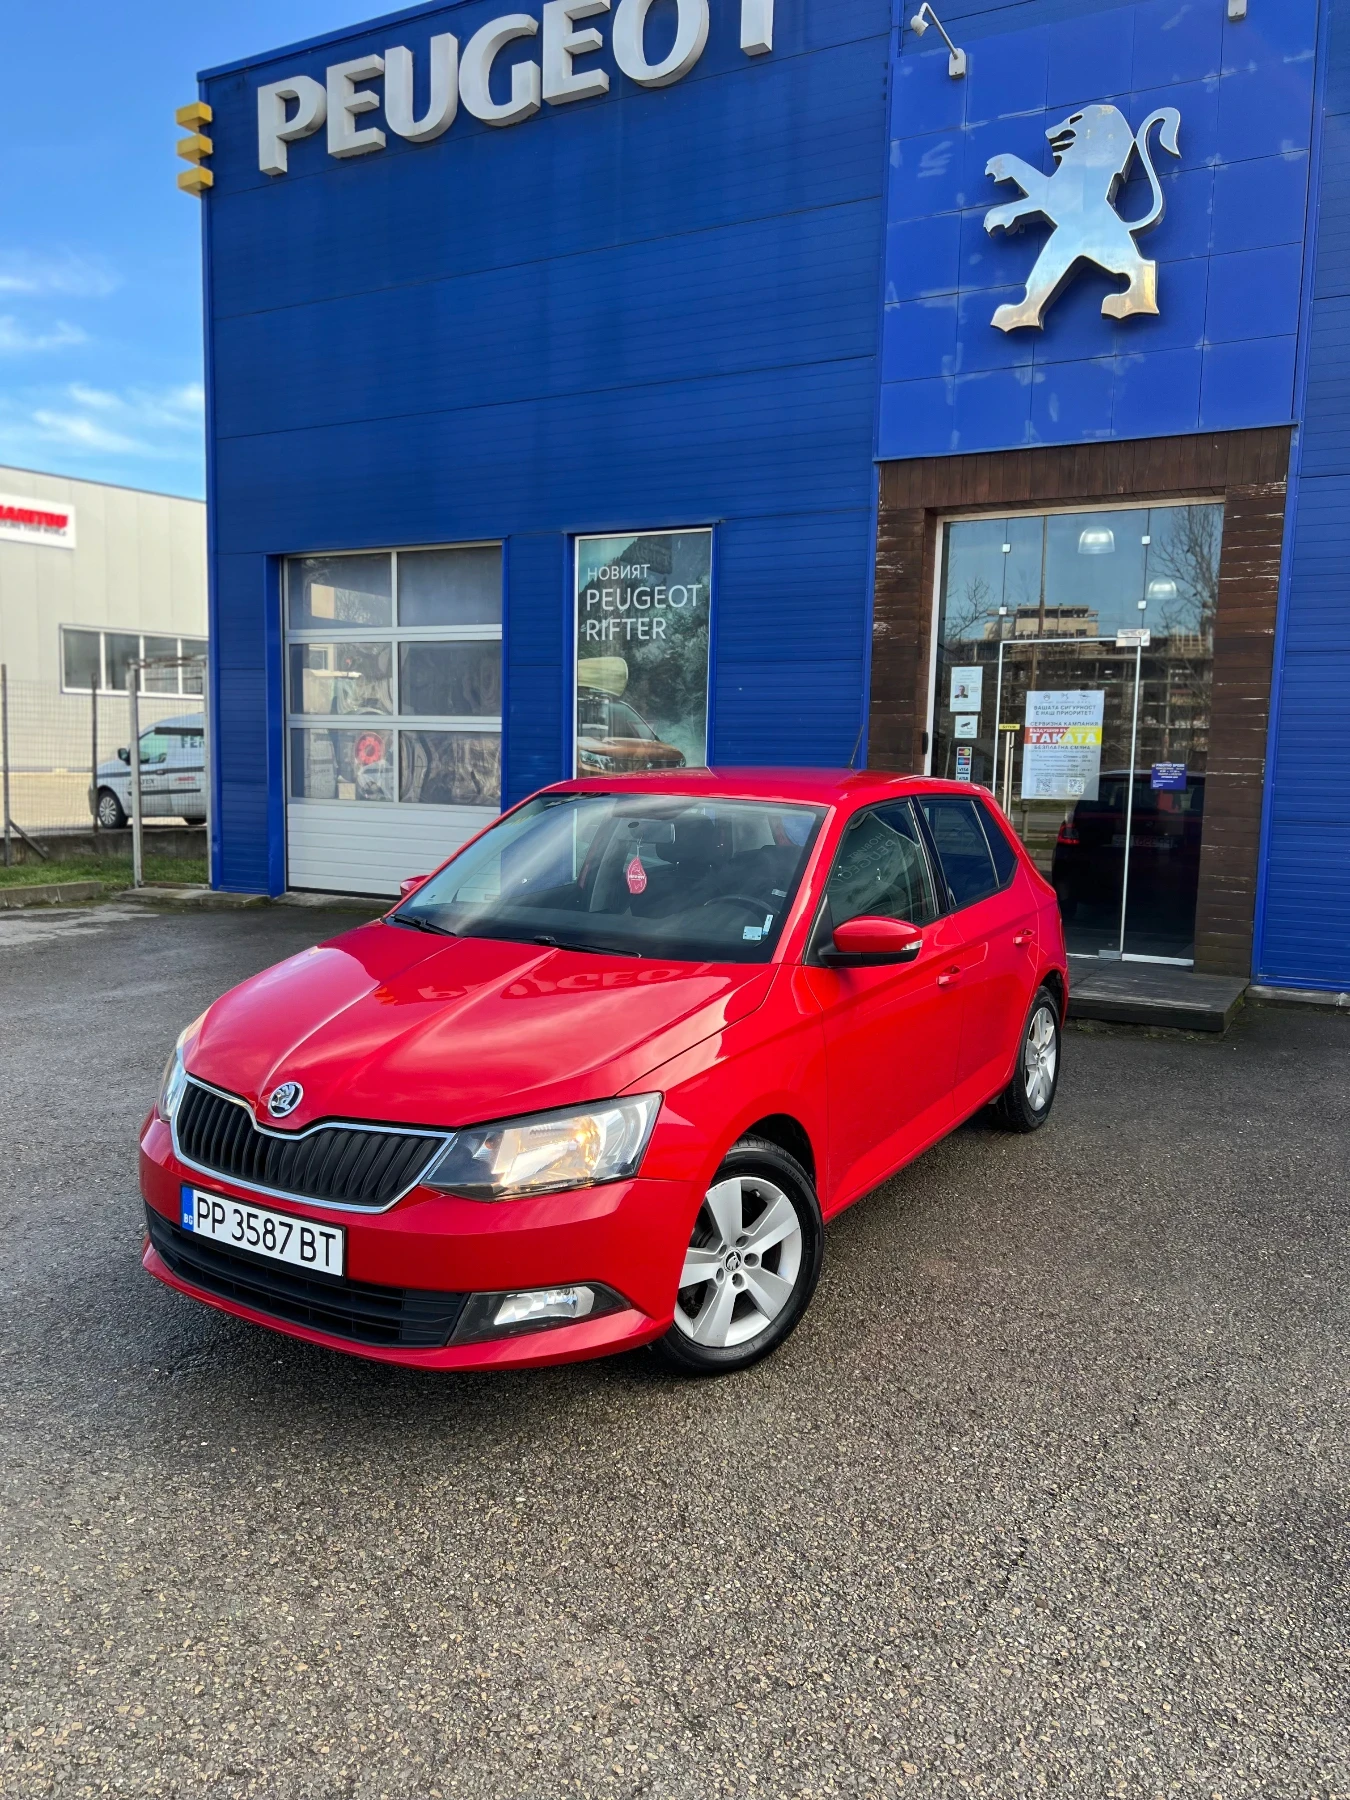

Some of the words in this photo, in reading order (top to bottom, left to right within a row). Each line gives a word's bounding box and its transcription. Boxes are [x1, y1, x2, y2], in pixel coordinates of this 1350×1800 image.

[587, 564, 651, 581] НОВИЯТ
[586, 584, 702, 611] PEUGEOT
[586, 617, 666, 641] RIFTER
[1029, 733, 1097, 743] ТАКАТА
[183, 1213, 194, 1226] BG
[197, 1196, 226, 1234] PP
[231, 1208, 294, 1255] 3587
[300, 1226, 337, 1267] BT
